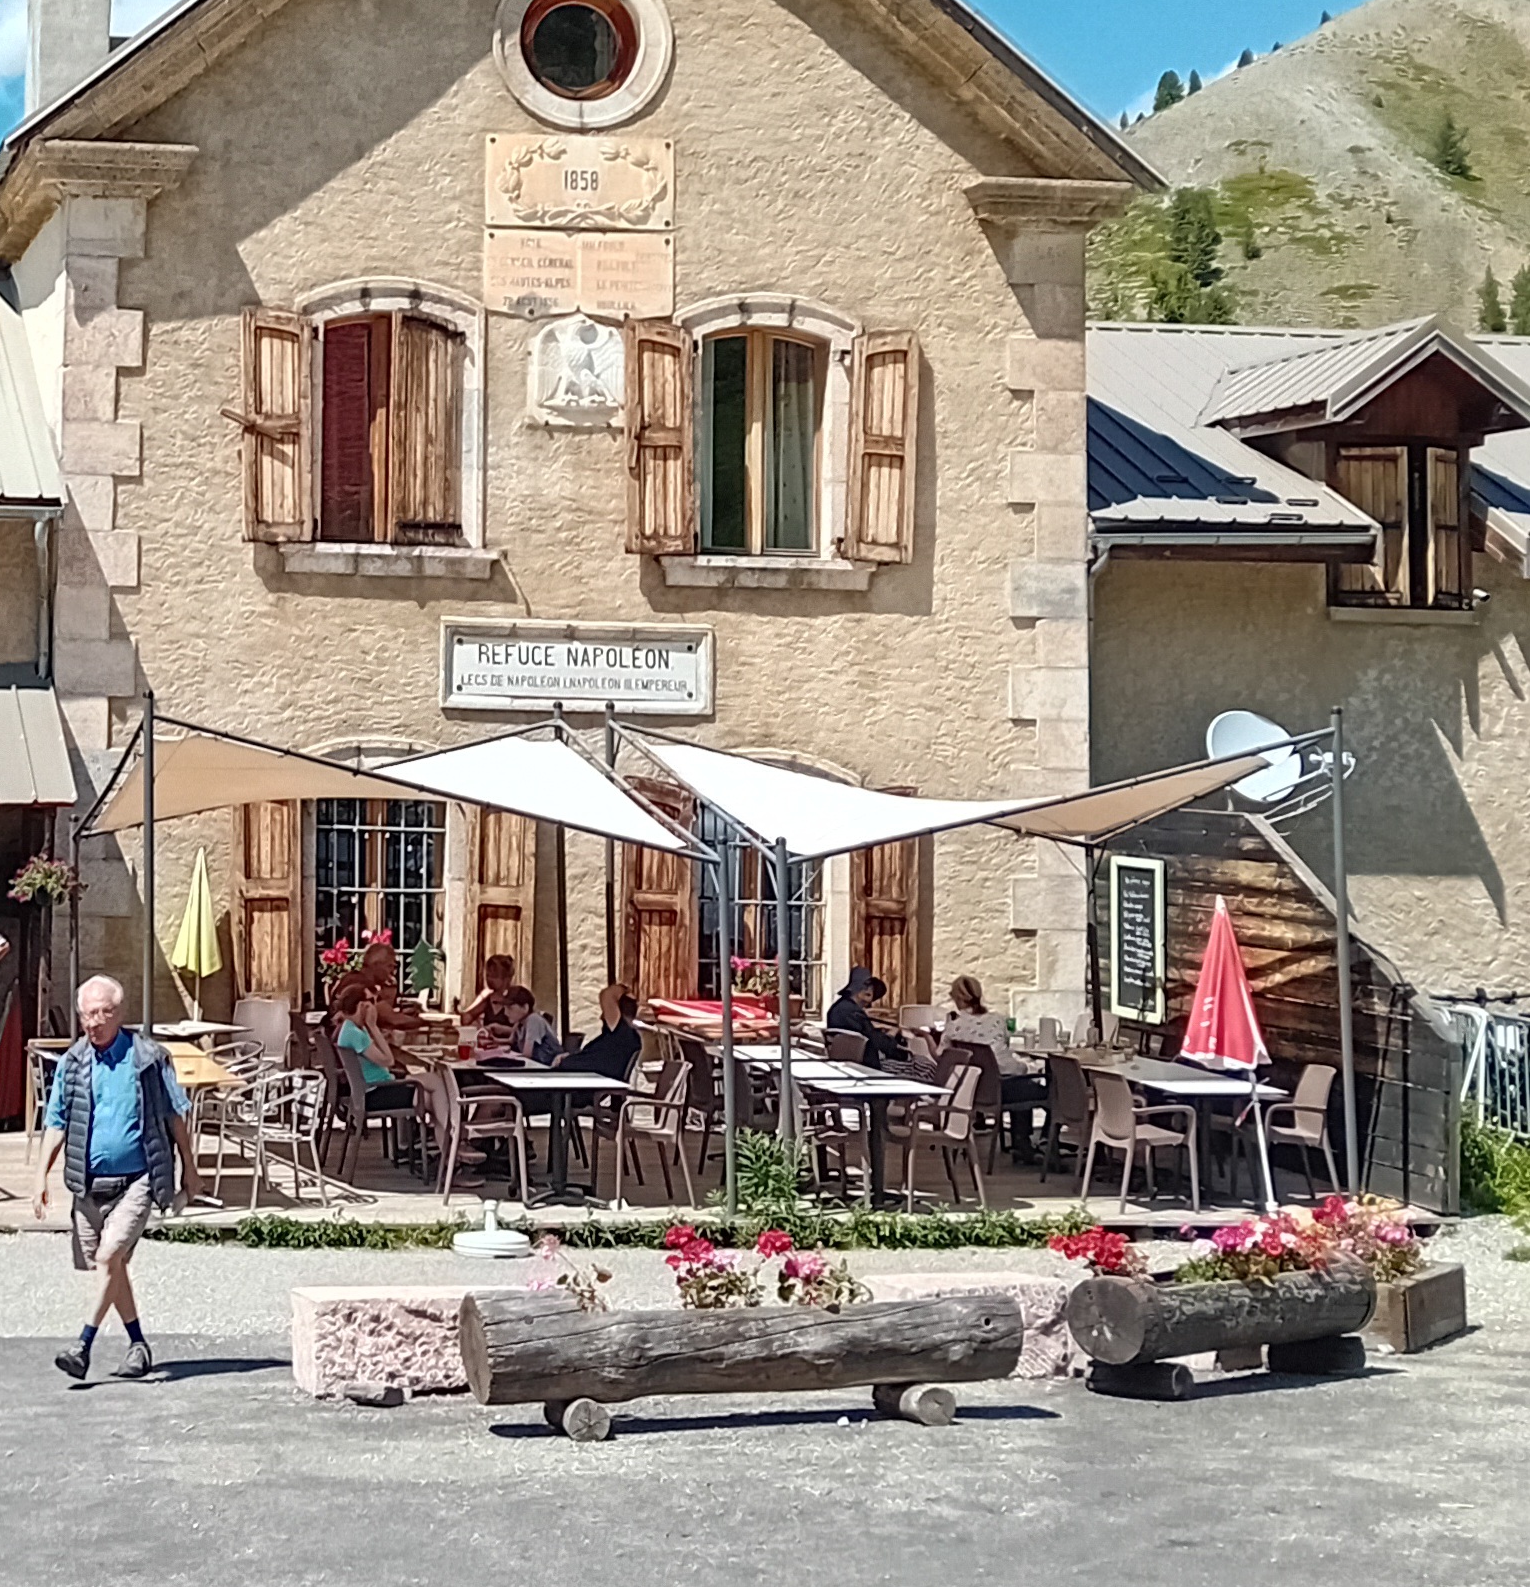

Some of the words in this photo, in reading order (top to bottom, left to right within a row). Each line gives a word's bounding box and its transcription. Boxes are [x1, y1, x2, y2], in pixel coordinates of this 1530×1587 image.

[564, 169, 599, 191] 1858
[478, 643, 556, 667] REFUGE
[490, 674, 504, 687] DE
